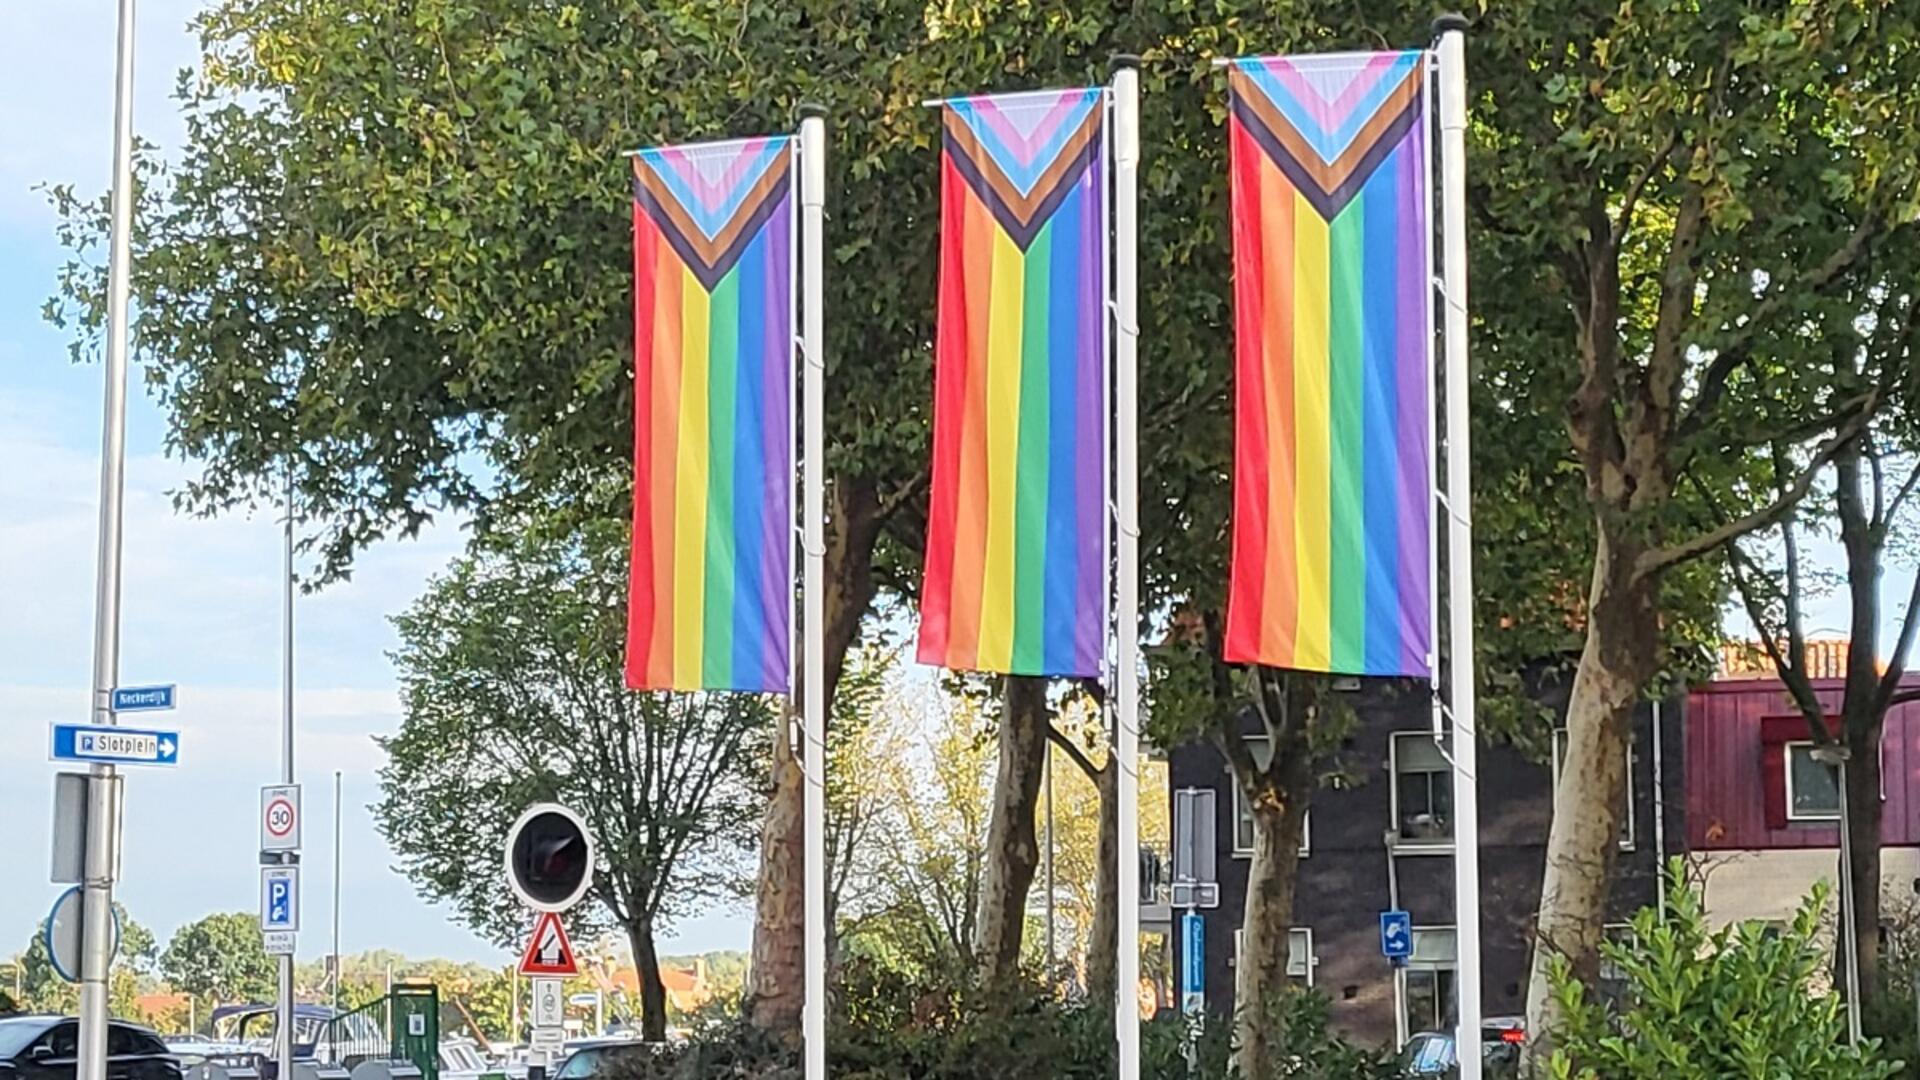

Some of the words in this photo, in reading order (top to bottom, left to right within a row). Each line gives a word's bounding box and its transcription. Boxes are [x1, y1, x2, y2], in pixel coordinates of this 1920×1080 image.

[99, 736, 156, 753] Slotplein
[272, 810, 290, 825] 30
[273, 883, 285, 906] P
